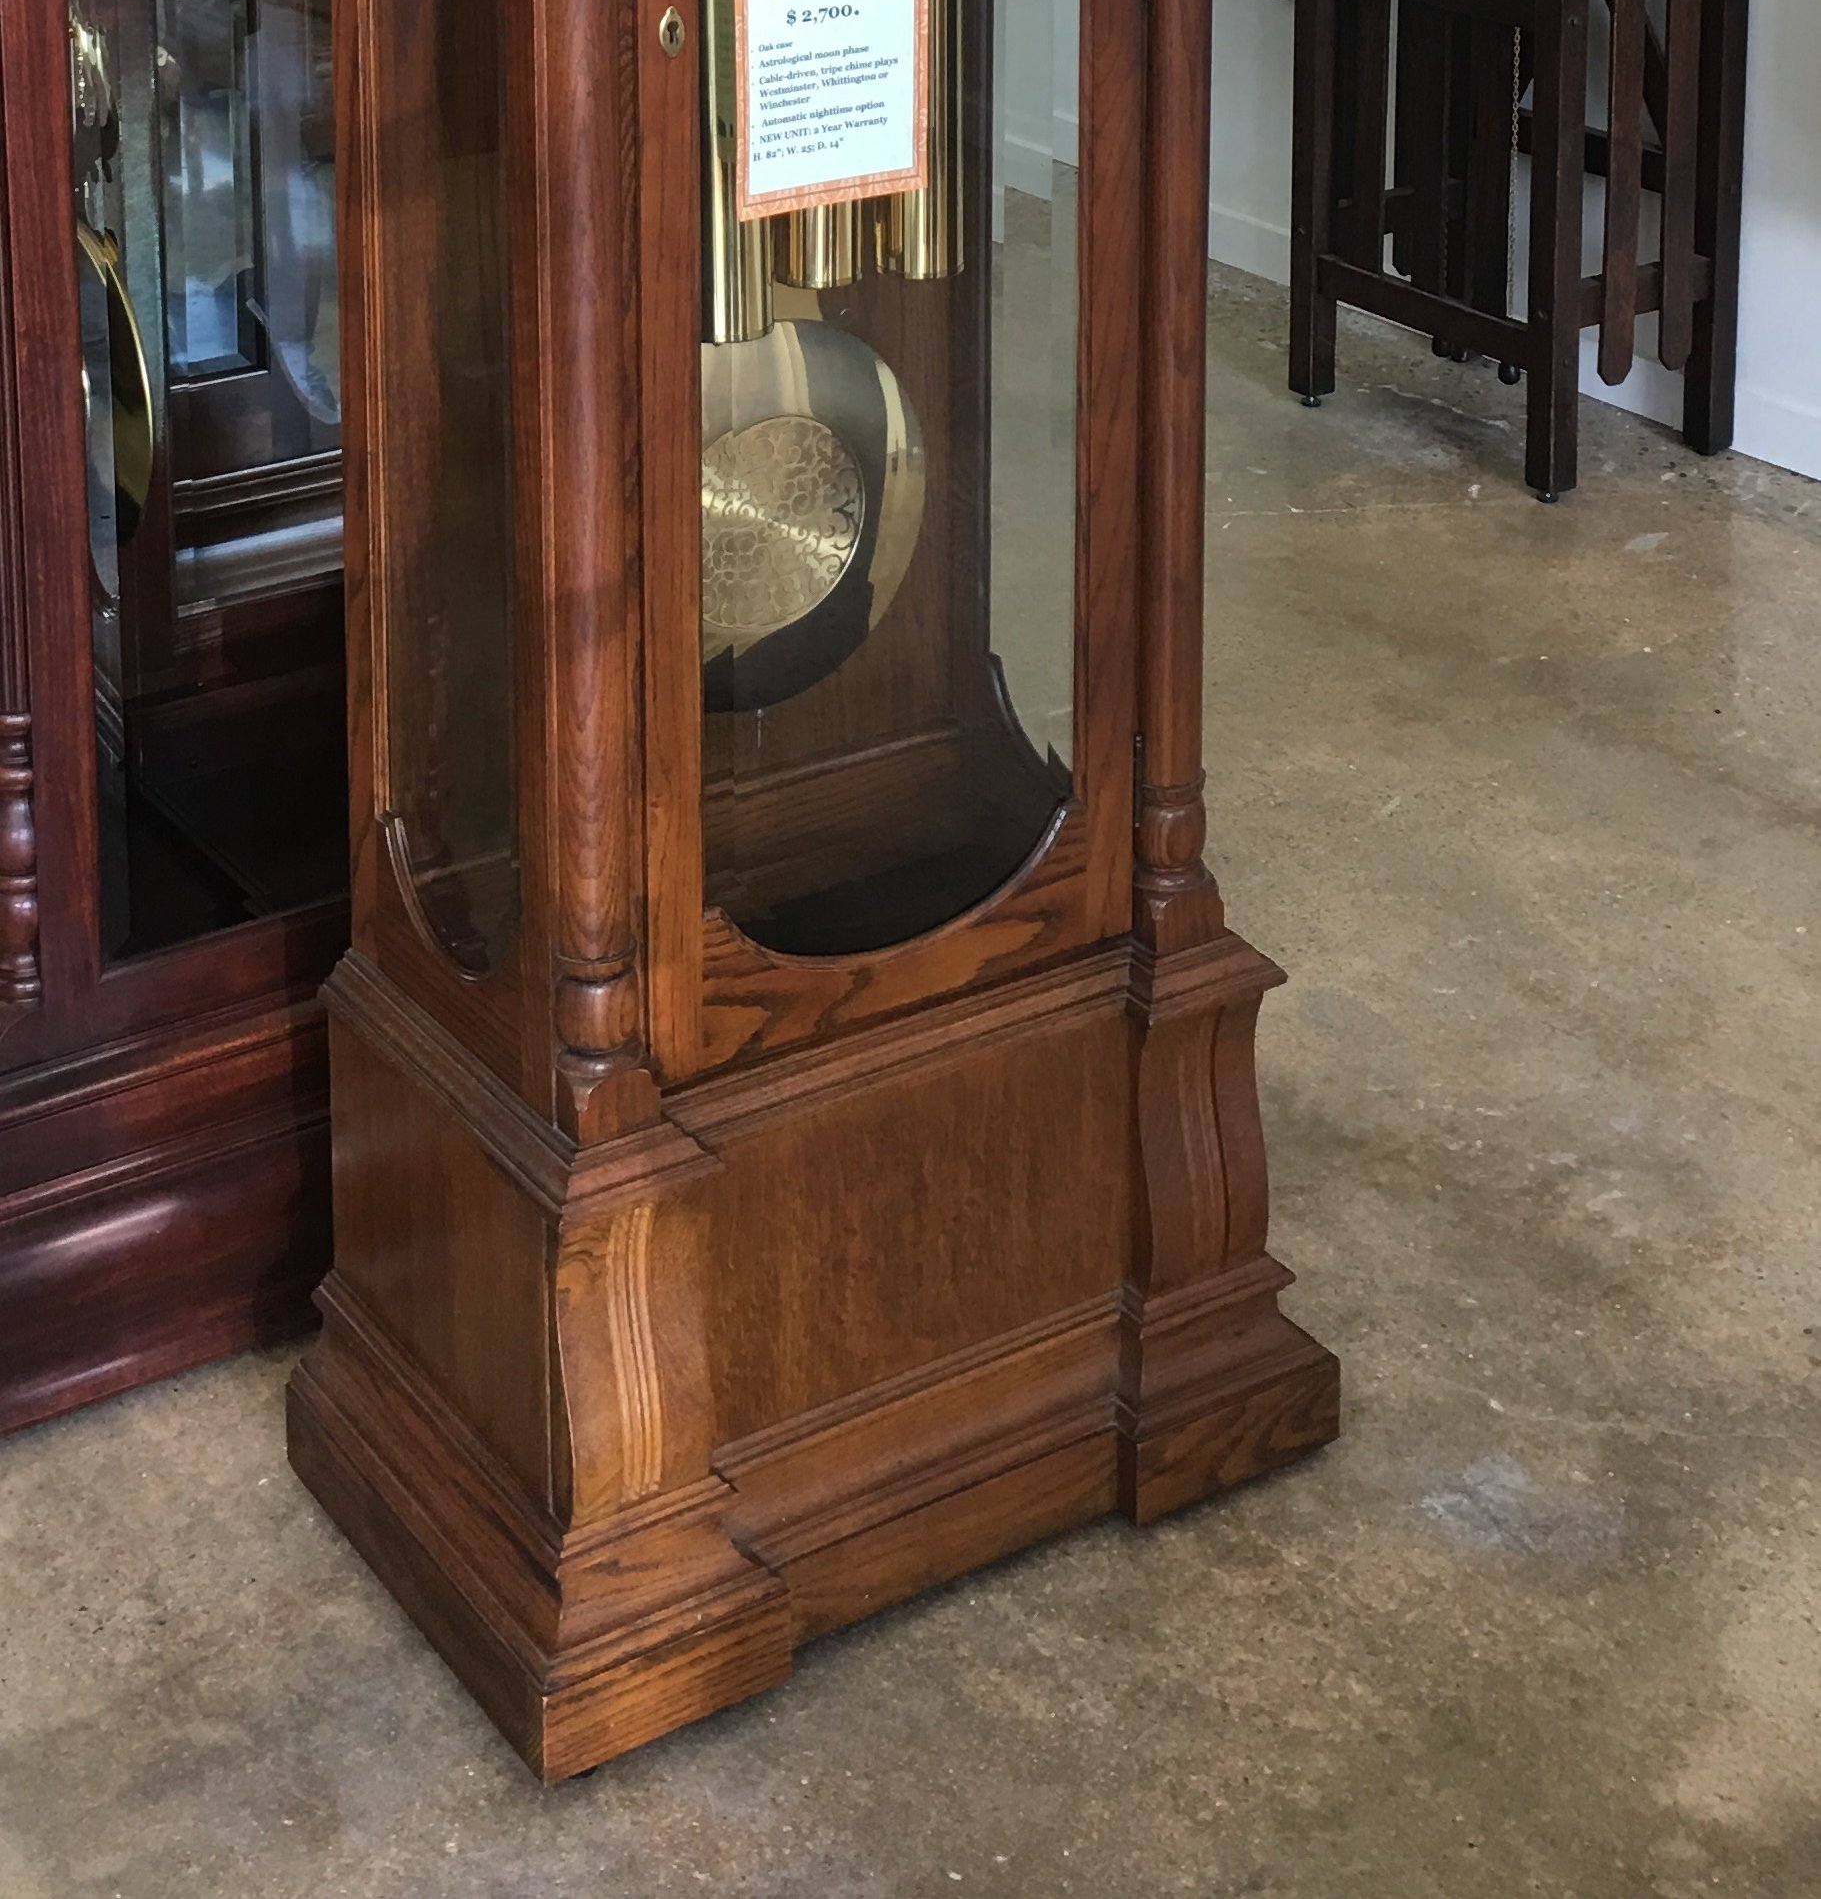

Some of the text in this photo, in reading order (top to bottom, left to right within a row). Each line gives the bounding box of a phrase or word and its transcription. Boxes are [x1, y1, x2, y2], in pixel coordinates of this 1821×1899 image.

[786, 4, 860, 27] $ 2,700.
[758, 41, 793, 52] Oak case
[759, 44, 870, 69] Astrological moon phase
[759, 57, 899, 85] Cable-driven, tripe chime plays
[759, 71, 889, 98] Westminster, Whittington or
[760, 95, 811, 111] Winchester
[761, 100, 885, 128] Automatic nighttime option
[760, 132, 782, 145] NEW
[821, 123, 843, 133] Year
[844, 115, 888, 130] Warranty
[786, 146, 799, 155] W.
[817, 141, 827, 150] D.
